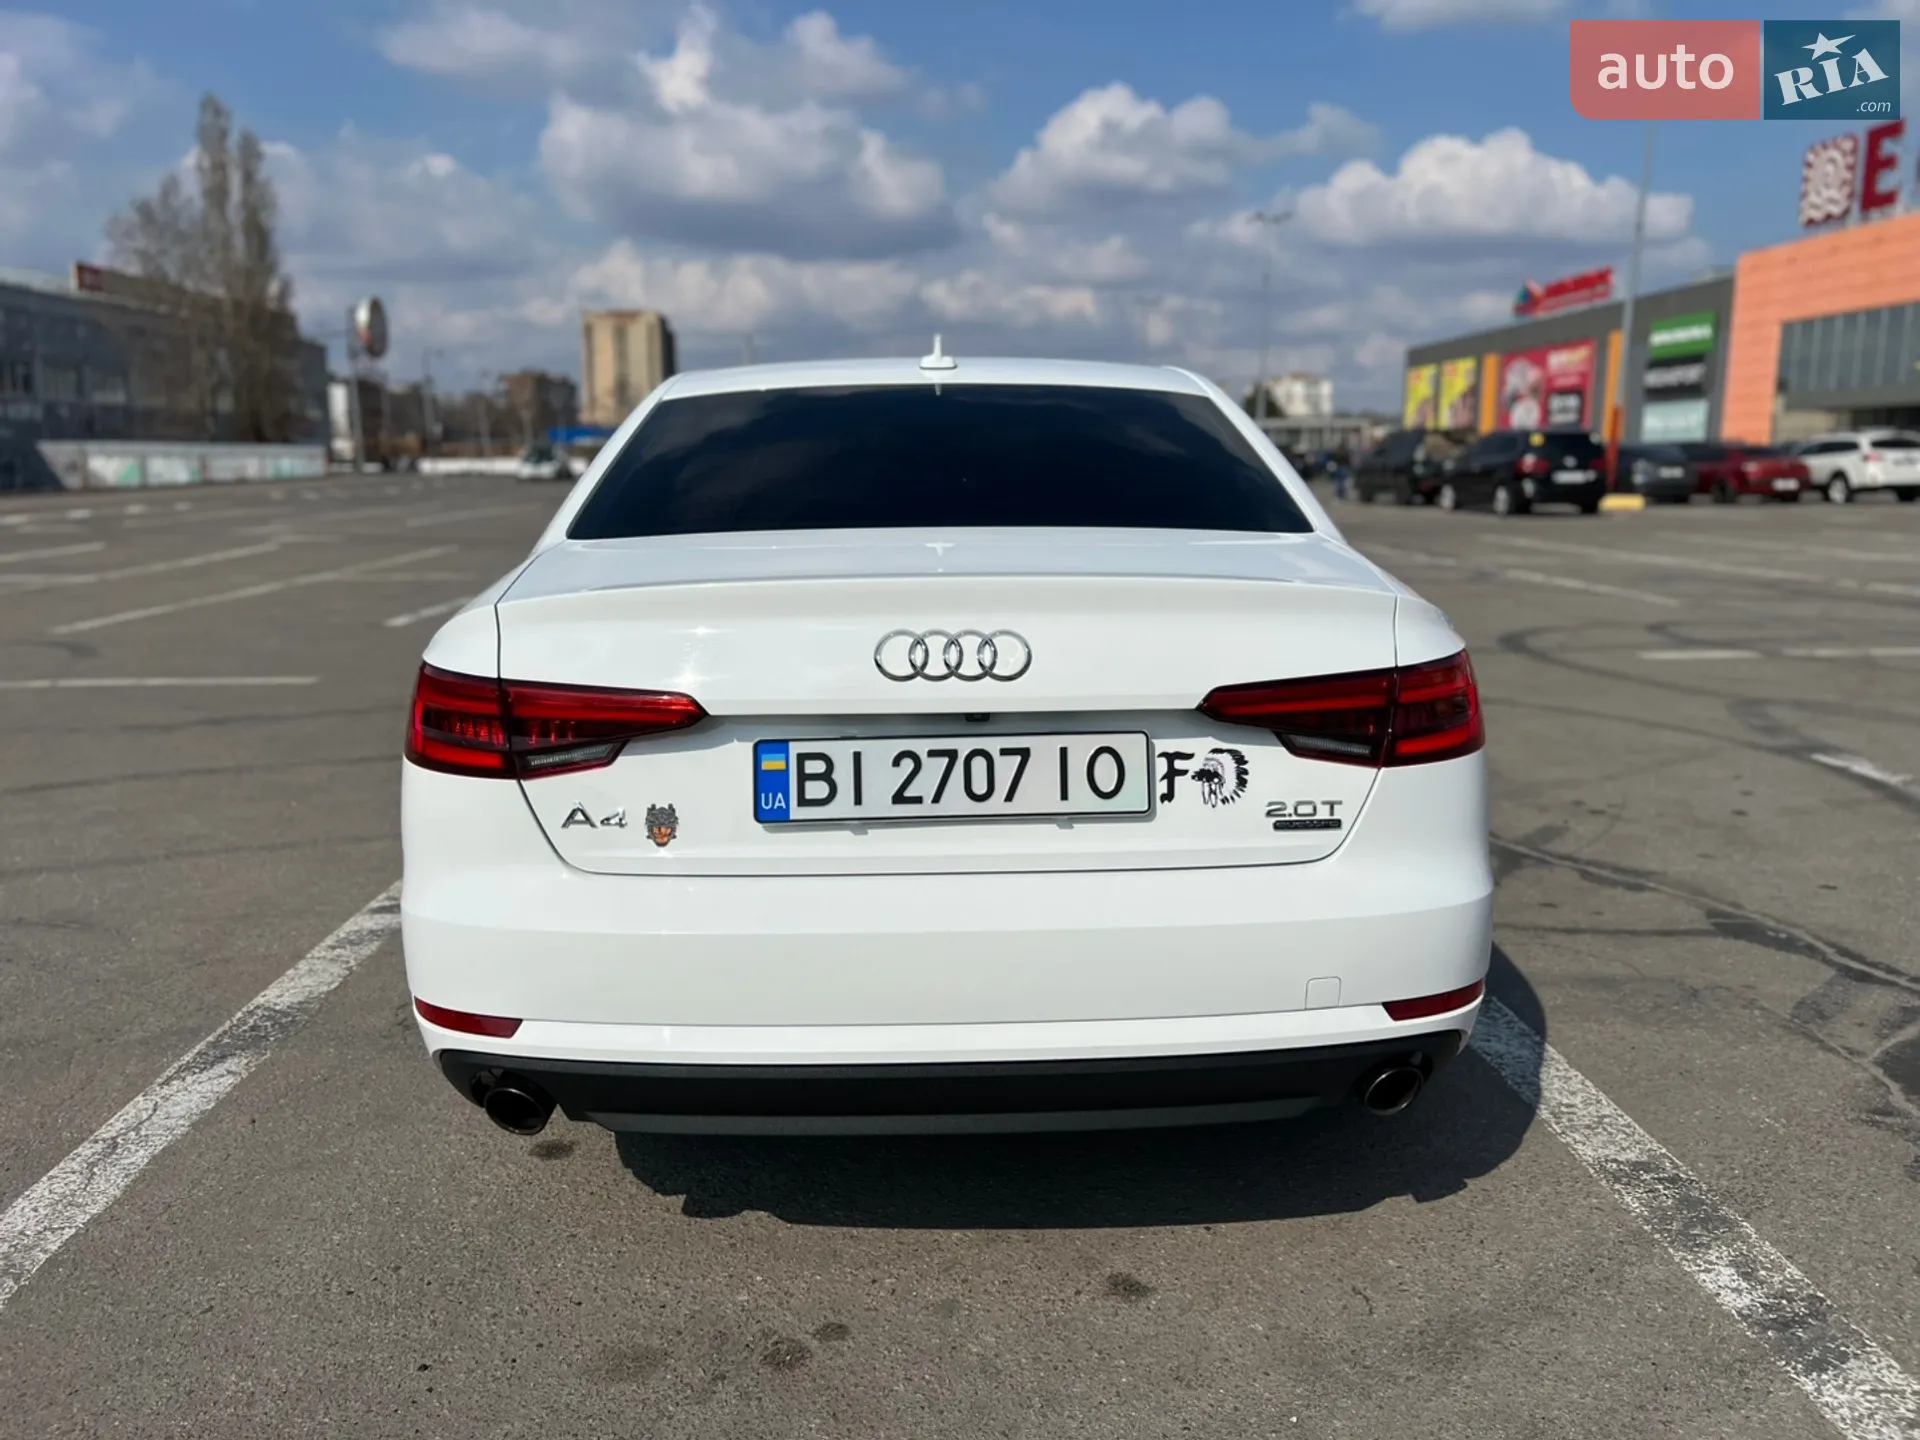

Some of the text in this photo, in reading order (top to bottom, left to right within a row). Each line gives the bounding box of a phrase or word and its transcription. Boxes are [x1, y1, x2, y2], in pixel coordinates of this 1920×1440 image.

[761, 793, 787, 810] UA
[796, 751, 863, 808] BI
[891, 747, 1032, 805] 2707
[1157, 751, 1195, 805] F
